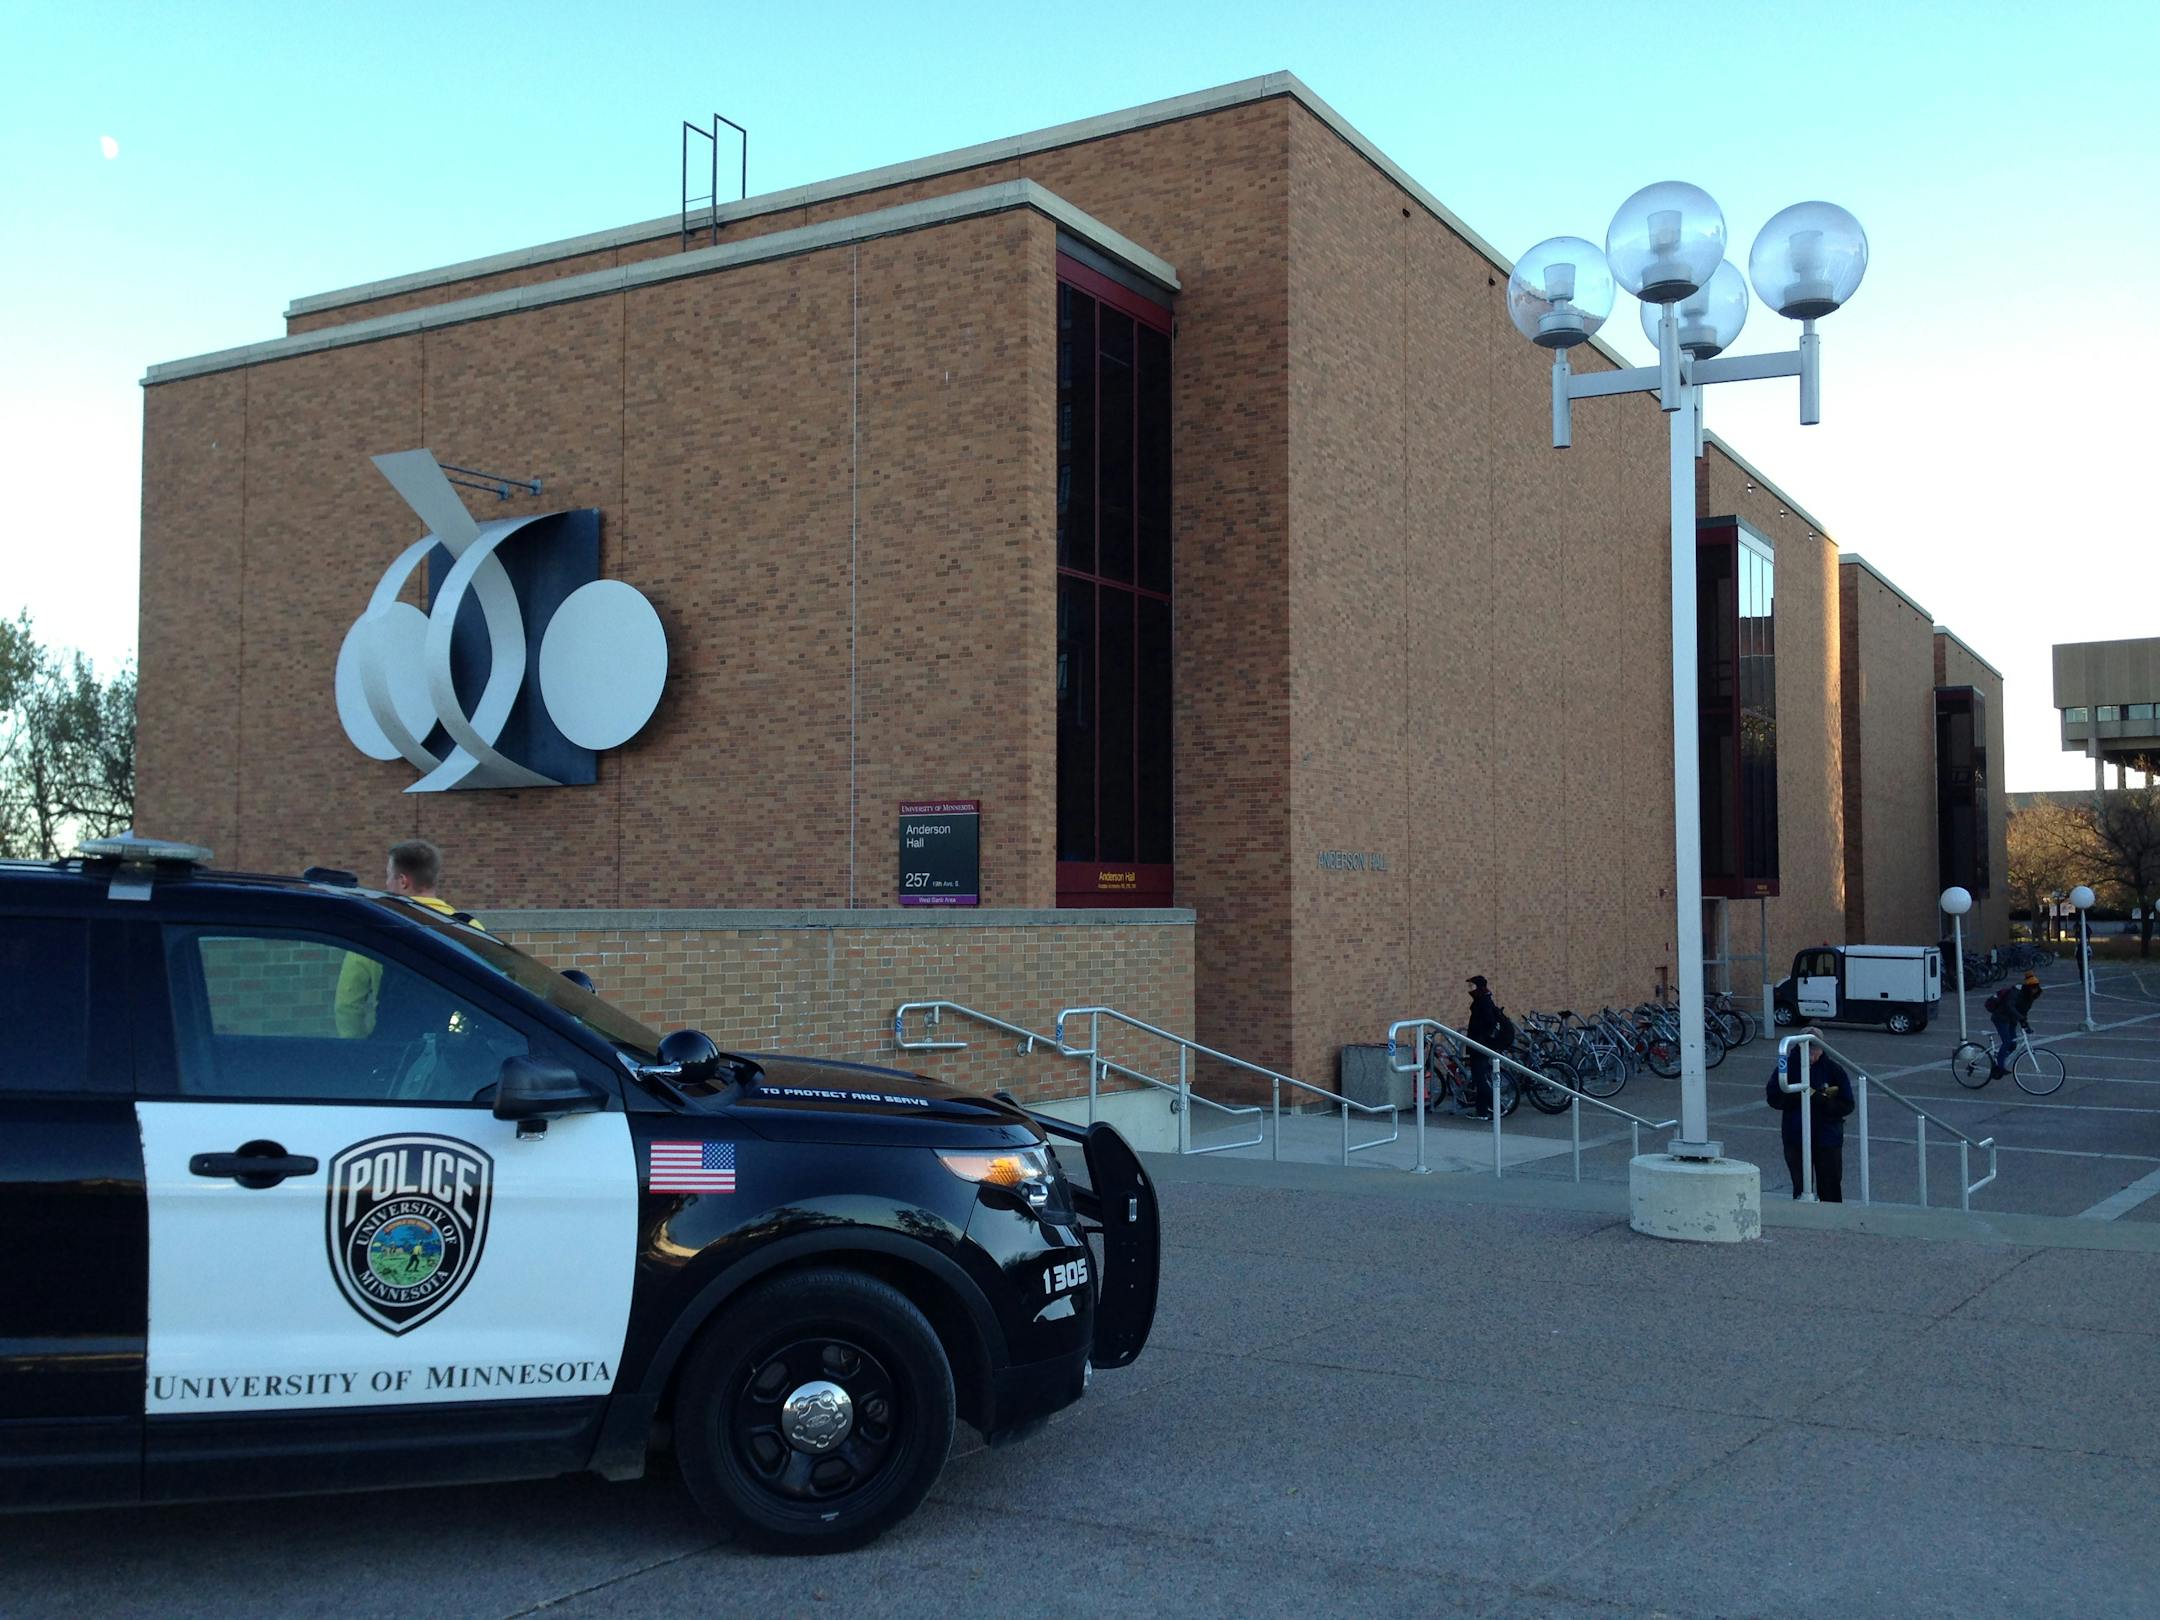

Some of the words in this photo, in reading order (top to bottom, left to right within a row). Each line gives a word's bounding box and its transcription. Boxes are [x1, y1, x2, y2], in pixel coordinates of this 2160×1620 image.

[906, 824, 951, 835] Anderson
[906, 838, 924, 848] Hall
[905, 872, 930, 888] 257
[1098, 871, 1124, 881] Anderson
[1125, 871, 1135, 881] Hall
[760, 1087, 780, 1095] TO
[784, 1089, 847, 1099] PROTECT
[851, 1093, 881, 1101] AND
[884, 1096, 929, 1106] SERVE
[345, 1150, 477, 1229] POLICE
[357, 1202, 446, 1246] UNIVERSITY
[442, 1225, 457, 1245] OF
[359, 1270, 448, 1301] MINNESOTA
[1043, 1258, 1088, 1294] 1305
